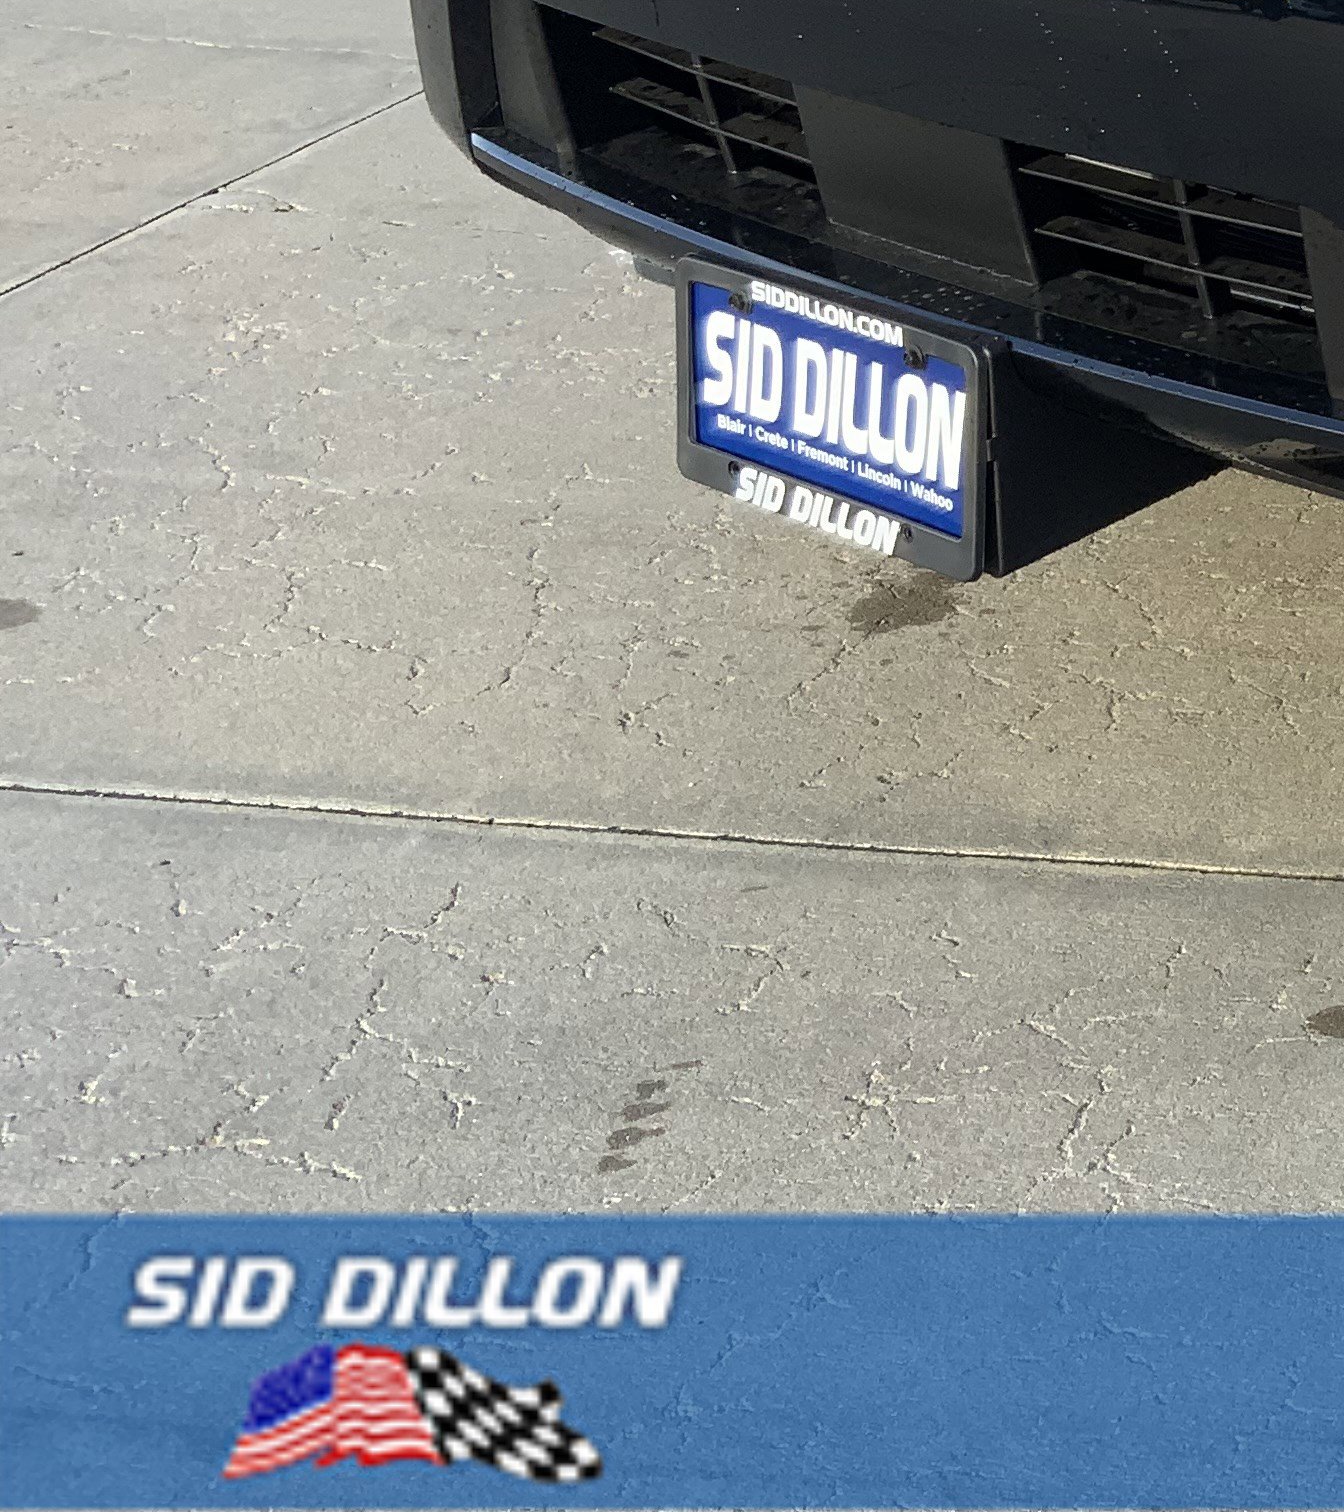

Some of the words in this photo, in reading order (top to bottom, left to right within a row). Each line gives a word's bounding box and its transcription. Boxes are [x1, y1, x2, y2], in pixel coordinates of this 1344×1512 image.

[750, 281, 904, 348] SIDDILLON.COM
[703, 310, 783, 424] SID
[793, 337, 966, 491] DILLON
[717, 413, 747, 436] Blair
[755, 425, 789, 451] Crete
[797, 440, 849, 472] Fremont
[857, 463, 901, 492] Lincoln
[909, 481, 954, 512] Wahoo
[734, 467, 787, 515] SID
[788, 485, 901, 557] DILLON
